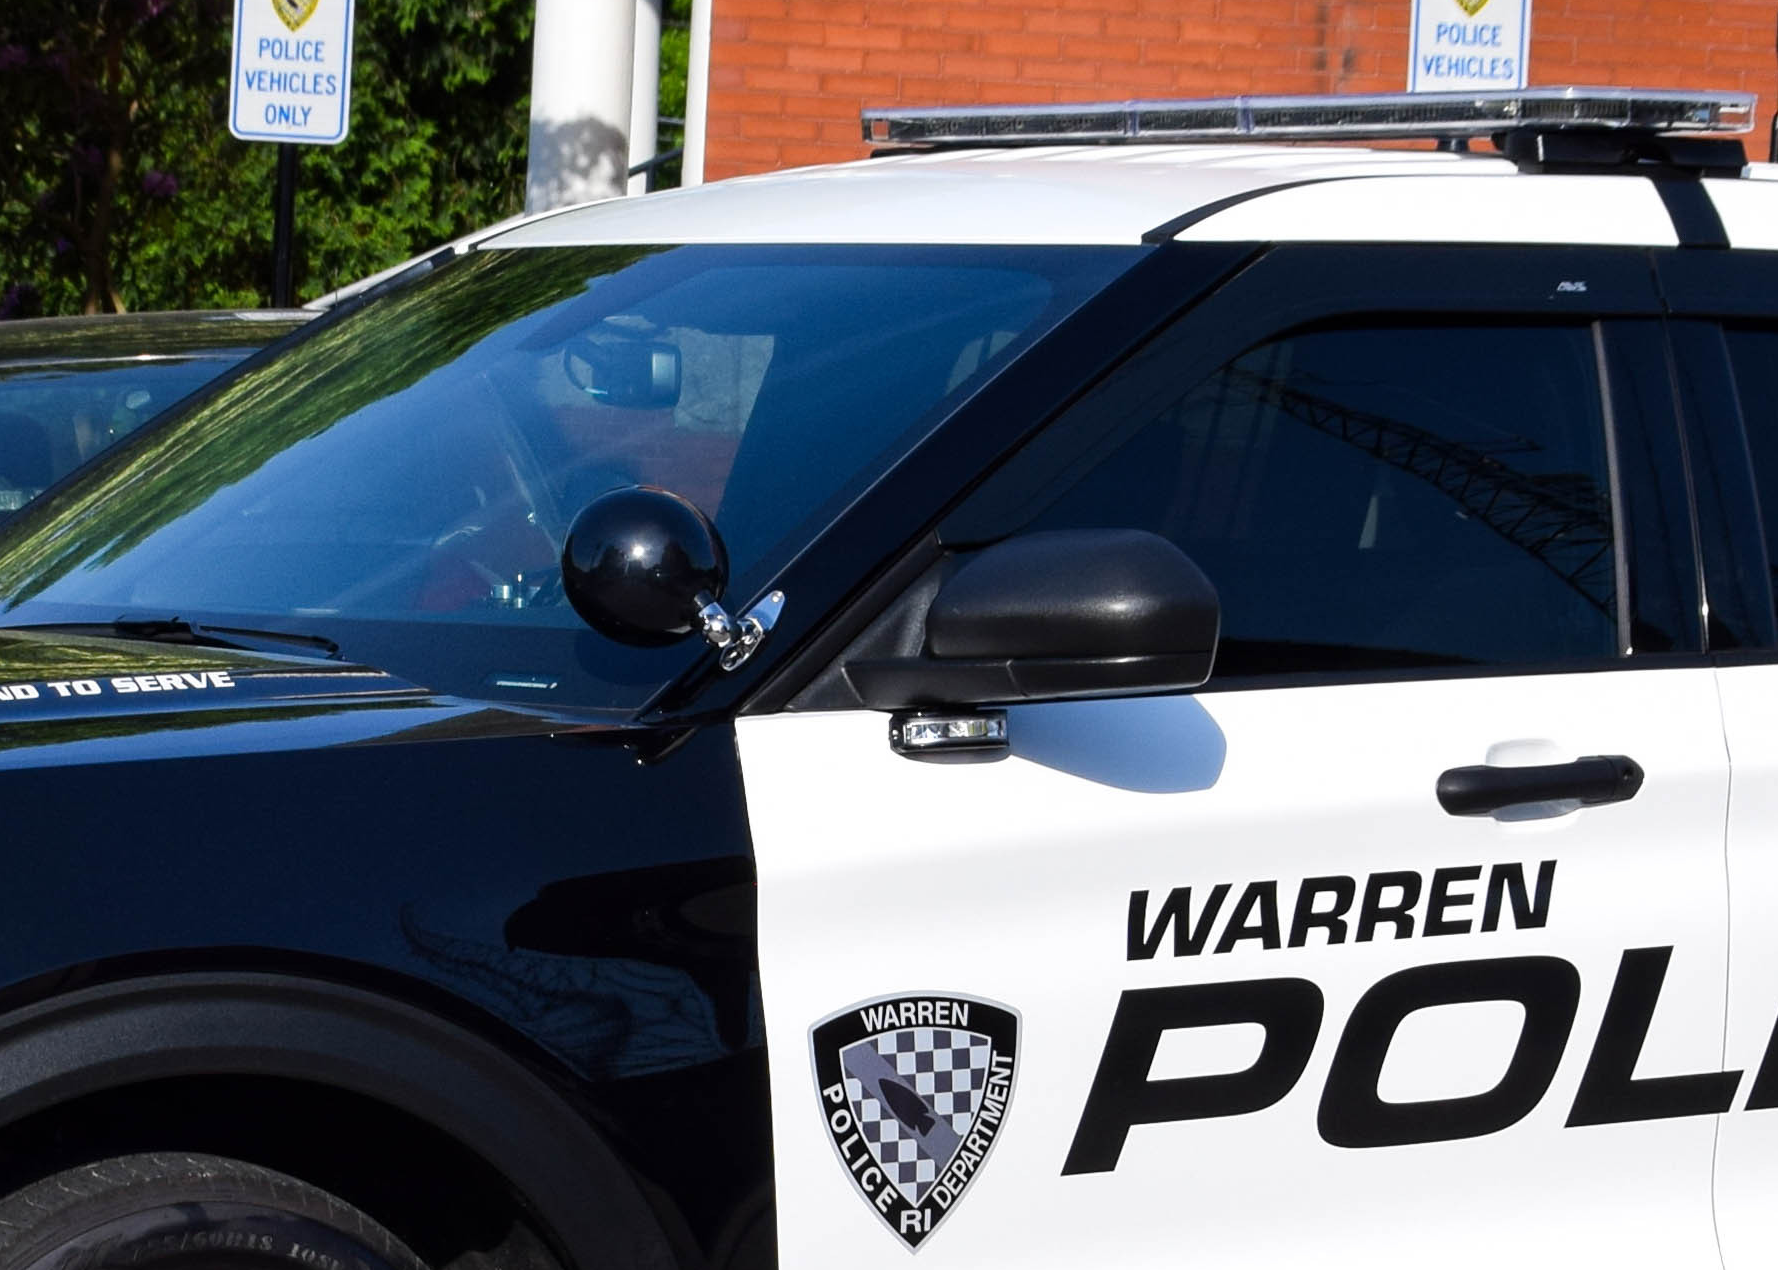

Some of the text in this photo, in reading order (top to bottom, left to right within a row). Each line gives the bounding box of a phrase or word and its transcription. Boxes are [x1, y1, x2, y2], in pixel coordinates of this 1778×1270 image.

[1435, 23, 1502, 47] POLICE
[258, 38, 325, 62] POLICE
[1423, 55, 1514, 80] VEHICLES
[245, 70, 337, 96] VEHICLES
[265, 104, 312, 127] ONLY
[47, 679, 103, 698] TO
[111, 671, 236, 694] SERVE
[1126, 859, 1558, 962] WARREN
[860, 1001, 969, 1033] WARREN
[931, 1049, 1014, 1210] DEPARTMENT
[822, 1082, 898, 1214] POLICE
[900, 1208, 932, 1234] RI
